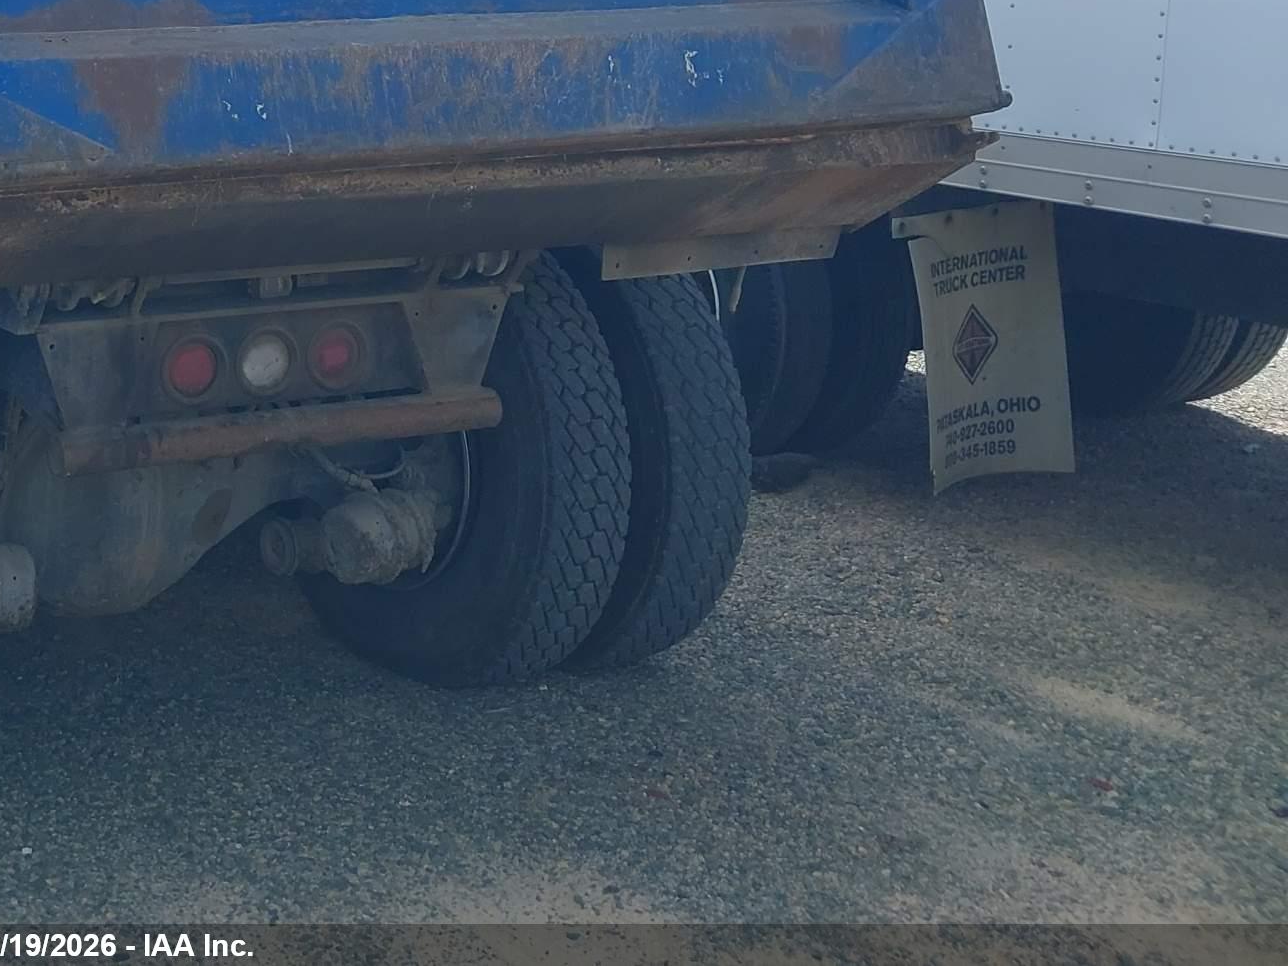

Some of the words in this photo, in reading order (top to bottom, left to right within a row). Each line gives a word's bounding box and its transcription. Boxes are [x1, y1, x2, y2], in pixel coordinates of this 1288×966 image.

[930, 245, 1028, 278] INTERNATIONAL
[934, 274, 969, 297] TRUCK
[970, 264, 1026, 288] CENTER
[996, 395, 1041, 414] OHIO
[944, 438, 1017, 470] -345-1859
